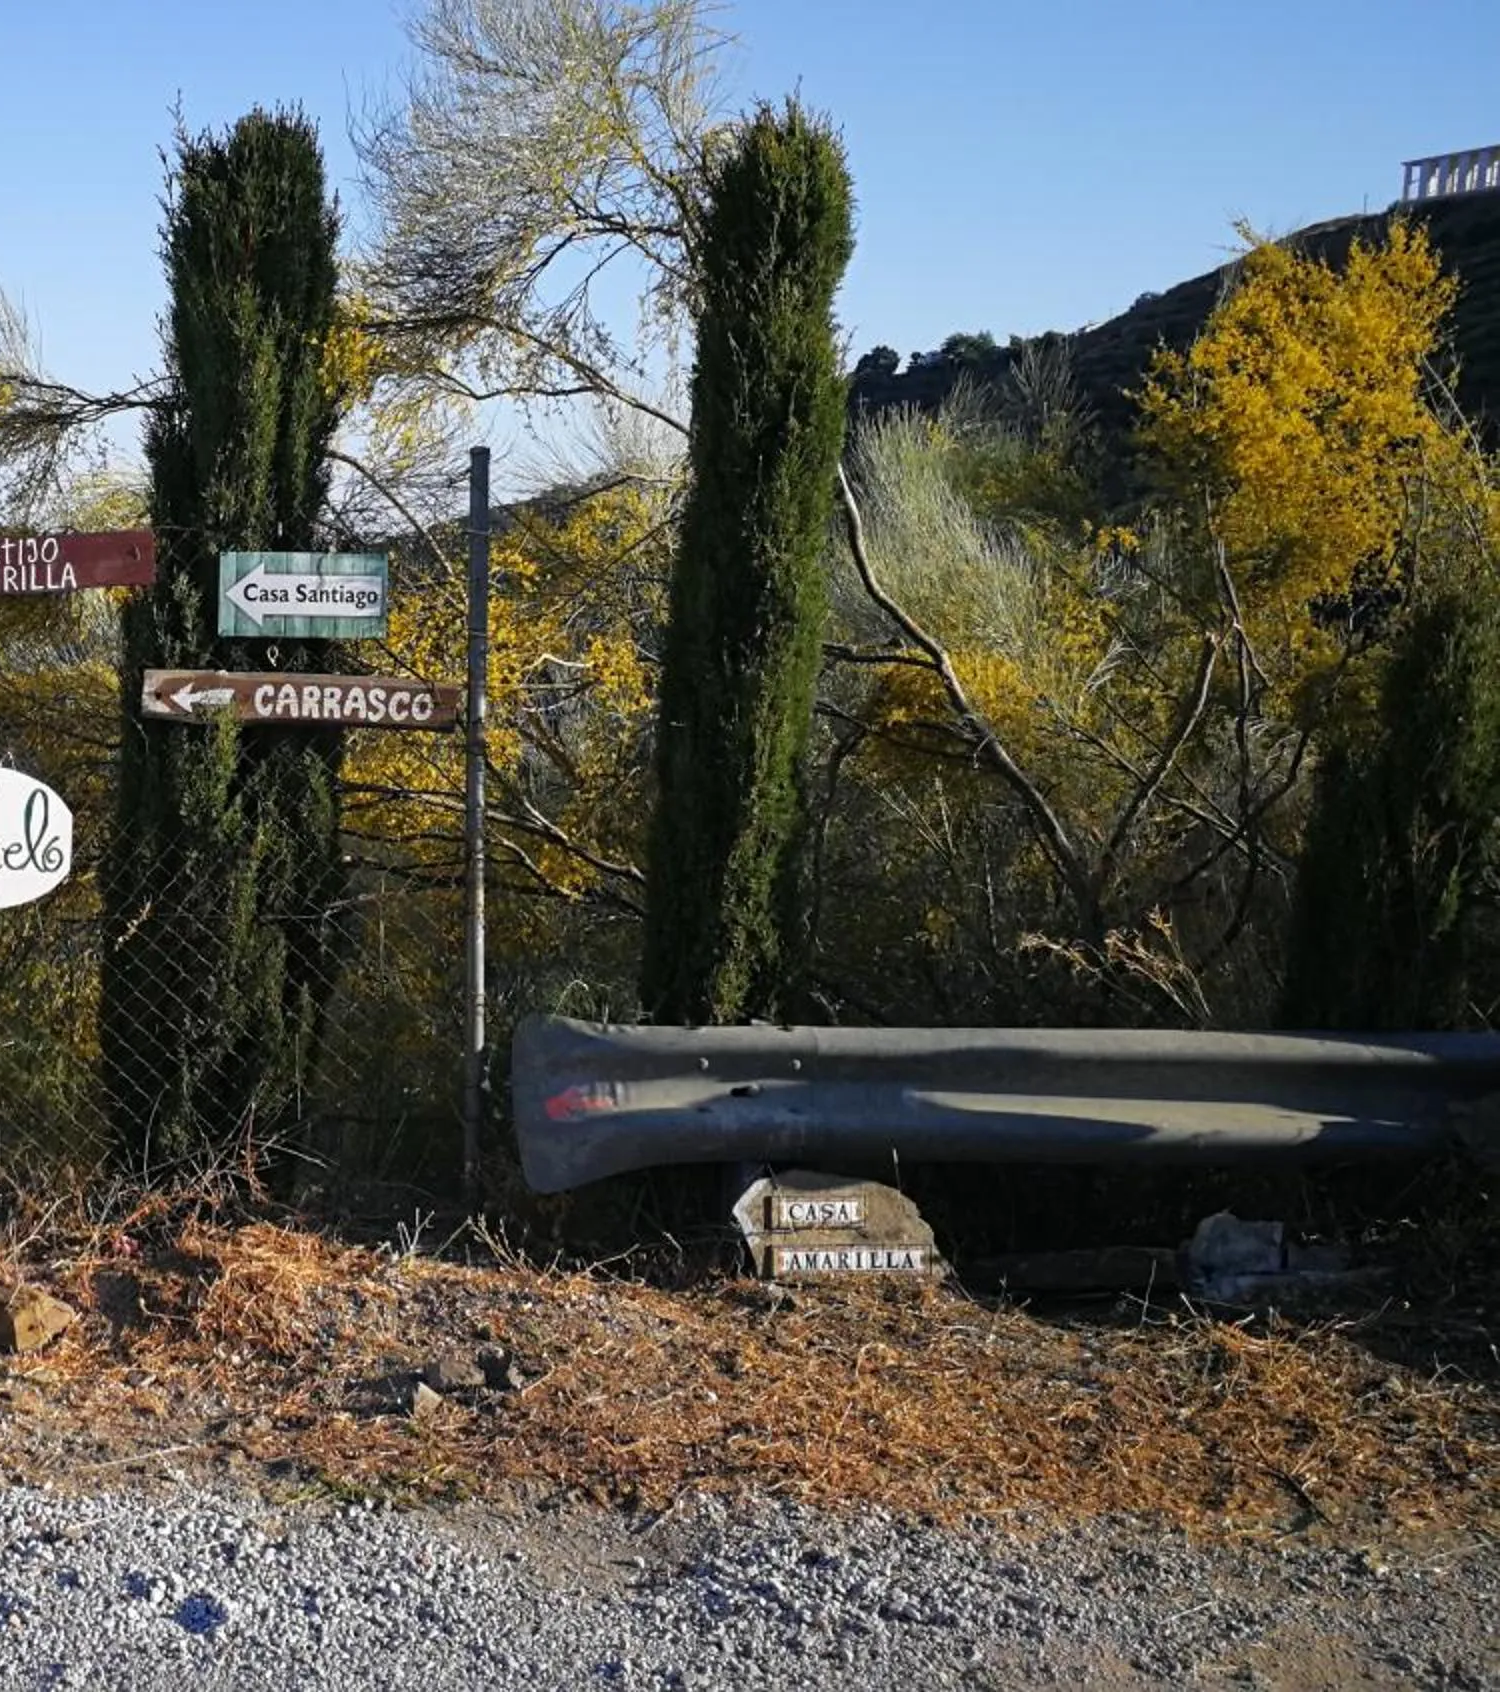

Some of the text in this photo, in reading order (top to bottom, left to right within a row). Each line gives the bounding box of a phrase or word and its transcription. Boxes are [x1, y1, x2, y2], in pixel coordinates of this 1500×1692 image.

[243, 583, 379, 610] Casa Santiago
[254, 683, 435, 723] CARRASCO
[788, 1203, 850, 1222] CASA
[789, 1252, 915, 1270] AMARILLA
